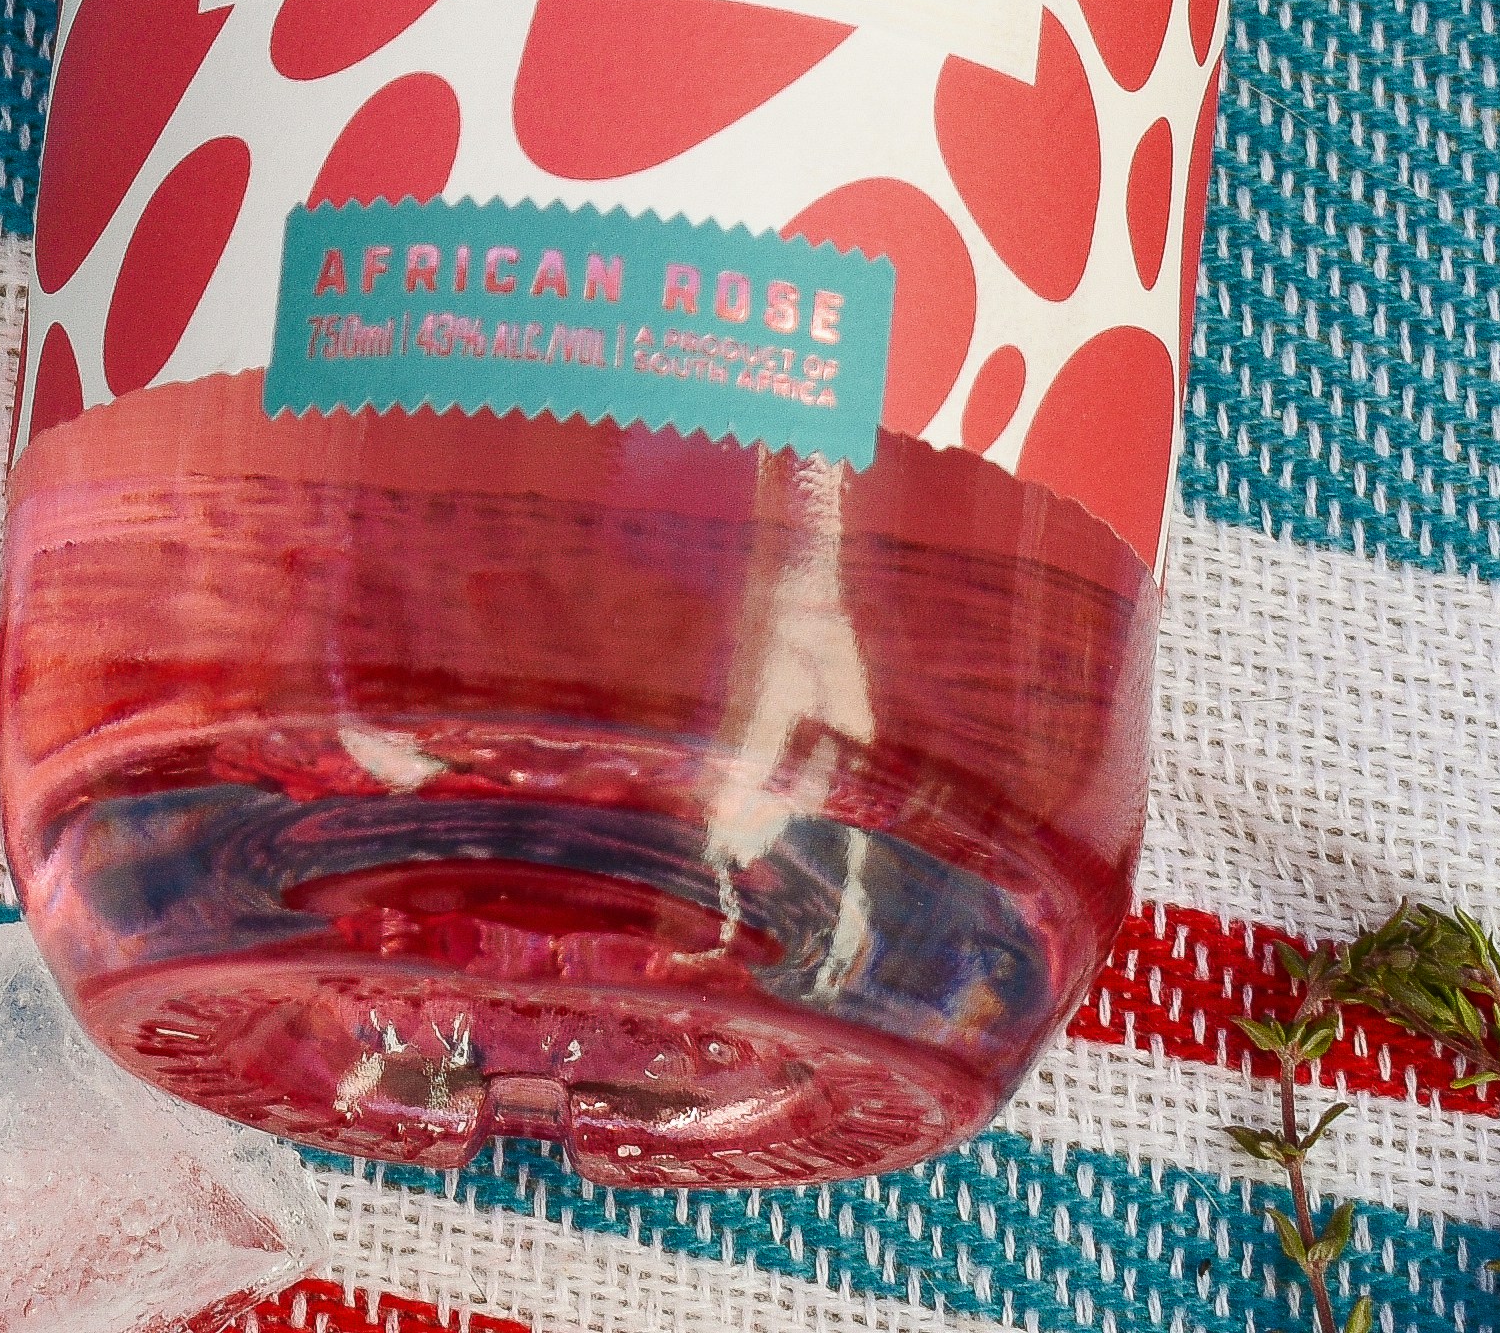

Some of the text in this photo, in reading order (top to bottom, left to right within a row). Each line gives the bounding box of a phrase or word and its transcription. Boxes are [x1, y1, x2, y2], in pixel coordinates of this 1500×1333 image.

[313, 244, 845, 345] AFRICAN ROSE
[634, 350, 836, 408] SOUTH AFRICA
[635, 326, 840, 381] A PRODUCT OF
